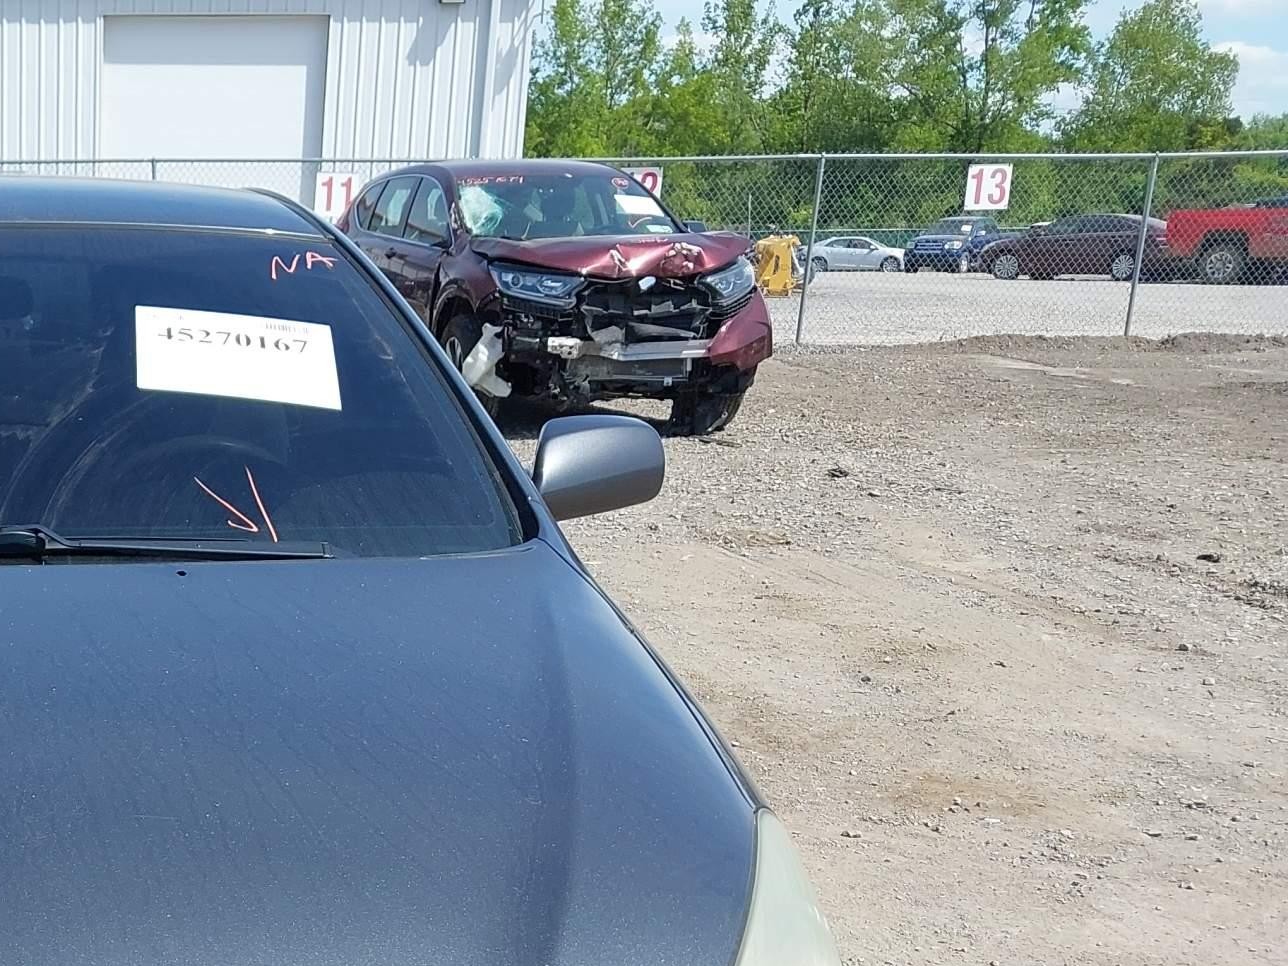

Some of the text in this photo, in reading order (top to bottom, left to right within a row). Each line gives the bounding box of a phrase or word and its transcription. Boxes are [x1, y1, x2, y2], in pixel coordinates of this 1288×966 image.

[321, 176, 353, 212] 11
[971, 168, 1008, 205] 13
[271, 251, 338, 280] NA
[158, 327, 308, 353] 45270167
